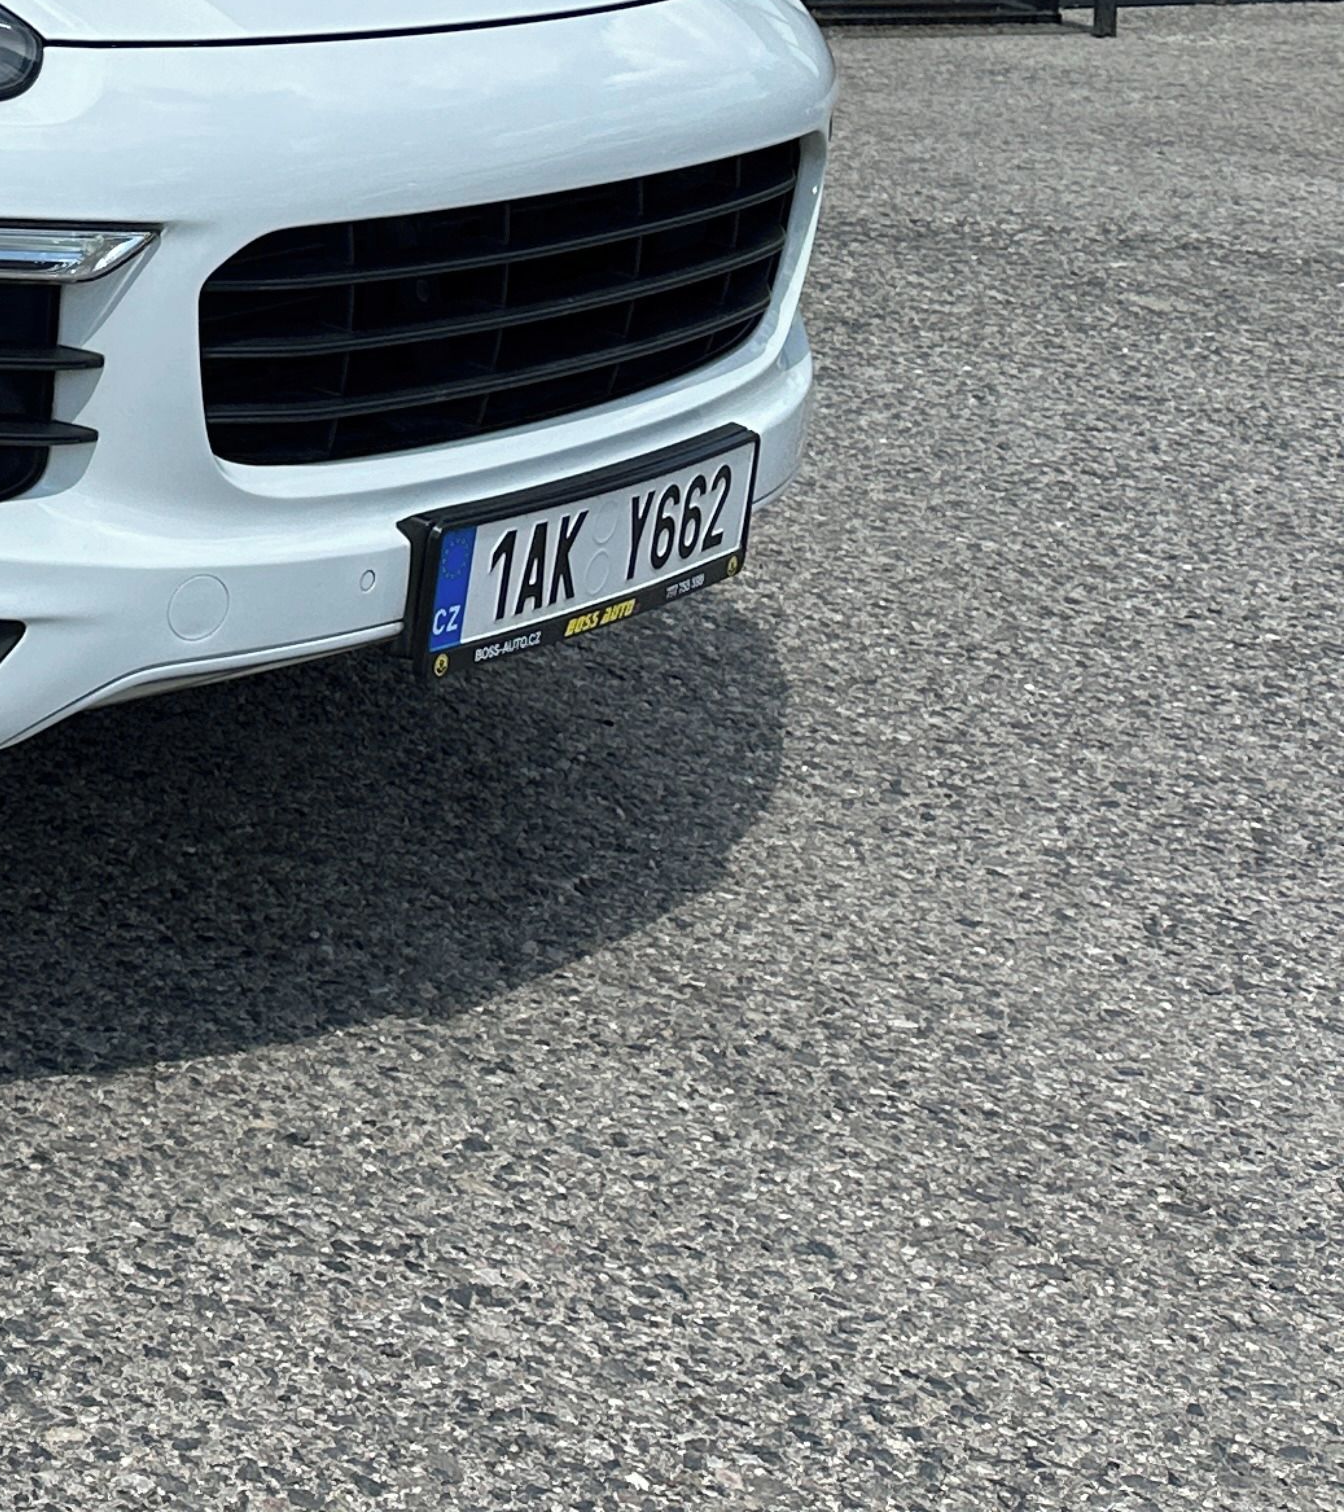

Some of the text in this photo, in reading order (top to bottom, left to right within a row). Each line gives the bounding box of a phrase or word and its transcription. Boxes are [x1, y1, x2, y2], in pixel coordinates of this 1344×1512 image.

[489, 464, 733, 621] 1AK Y662
[432, 605, 461, 637] CZ
[564, 597, 636, 637] BOSS AUTO
[474, 630, 542, 662] BOSS-AUTO.CZ
